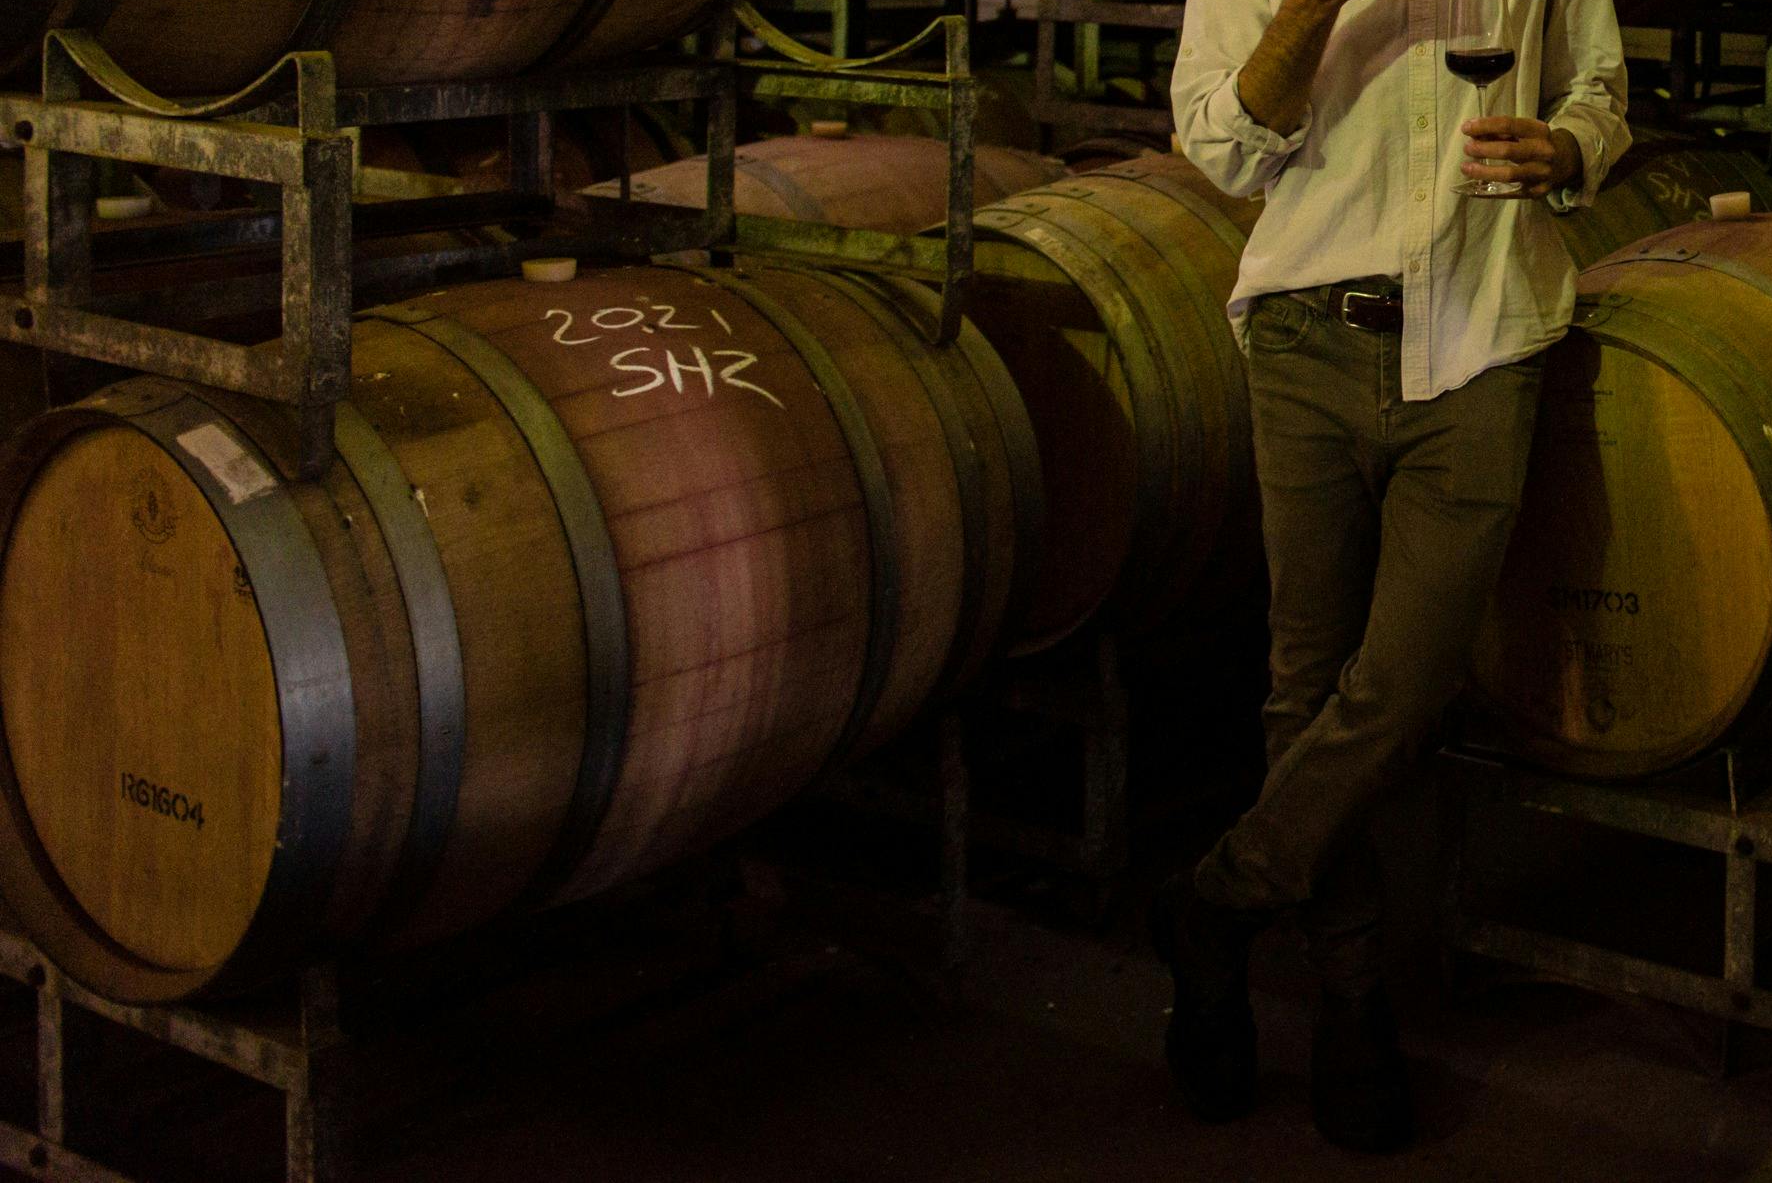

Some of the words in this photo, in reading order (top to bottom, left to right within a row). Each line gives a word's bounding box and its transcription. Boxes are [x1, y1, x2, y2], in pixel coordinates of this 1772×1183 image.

[544, 304, 732, 346] 2021
[609, 346, 787, 410] SHZ
[121, 771, 205, 831] RG1604
